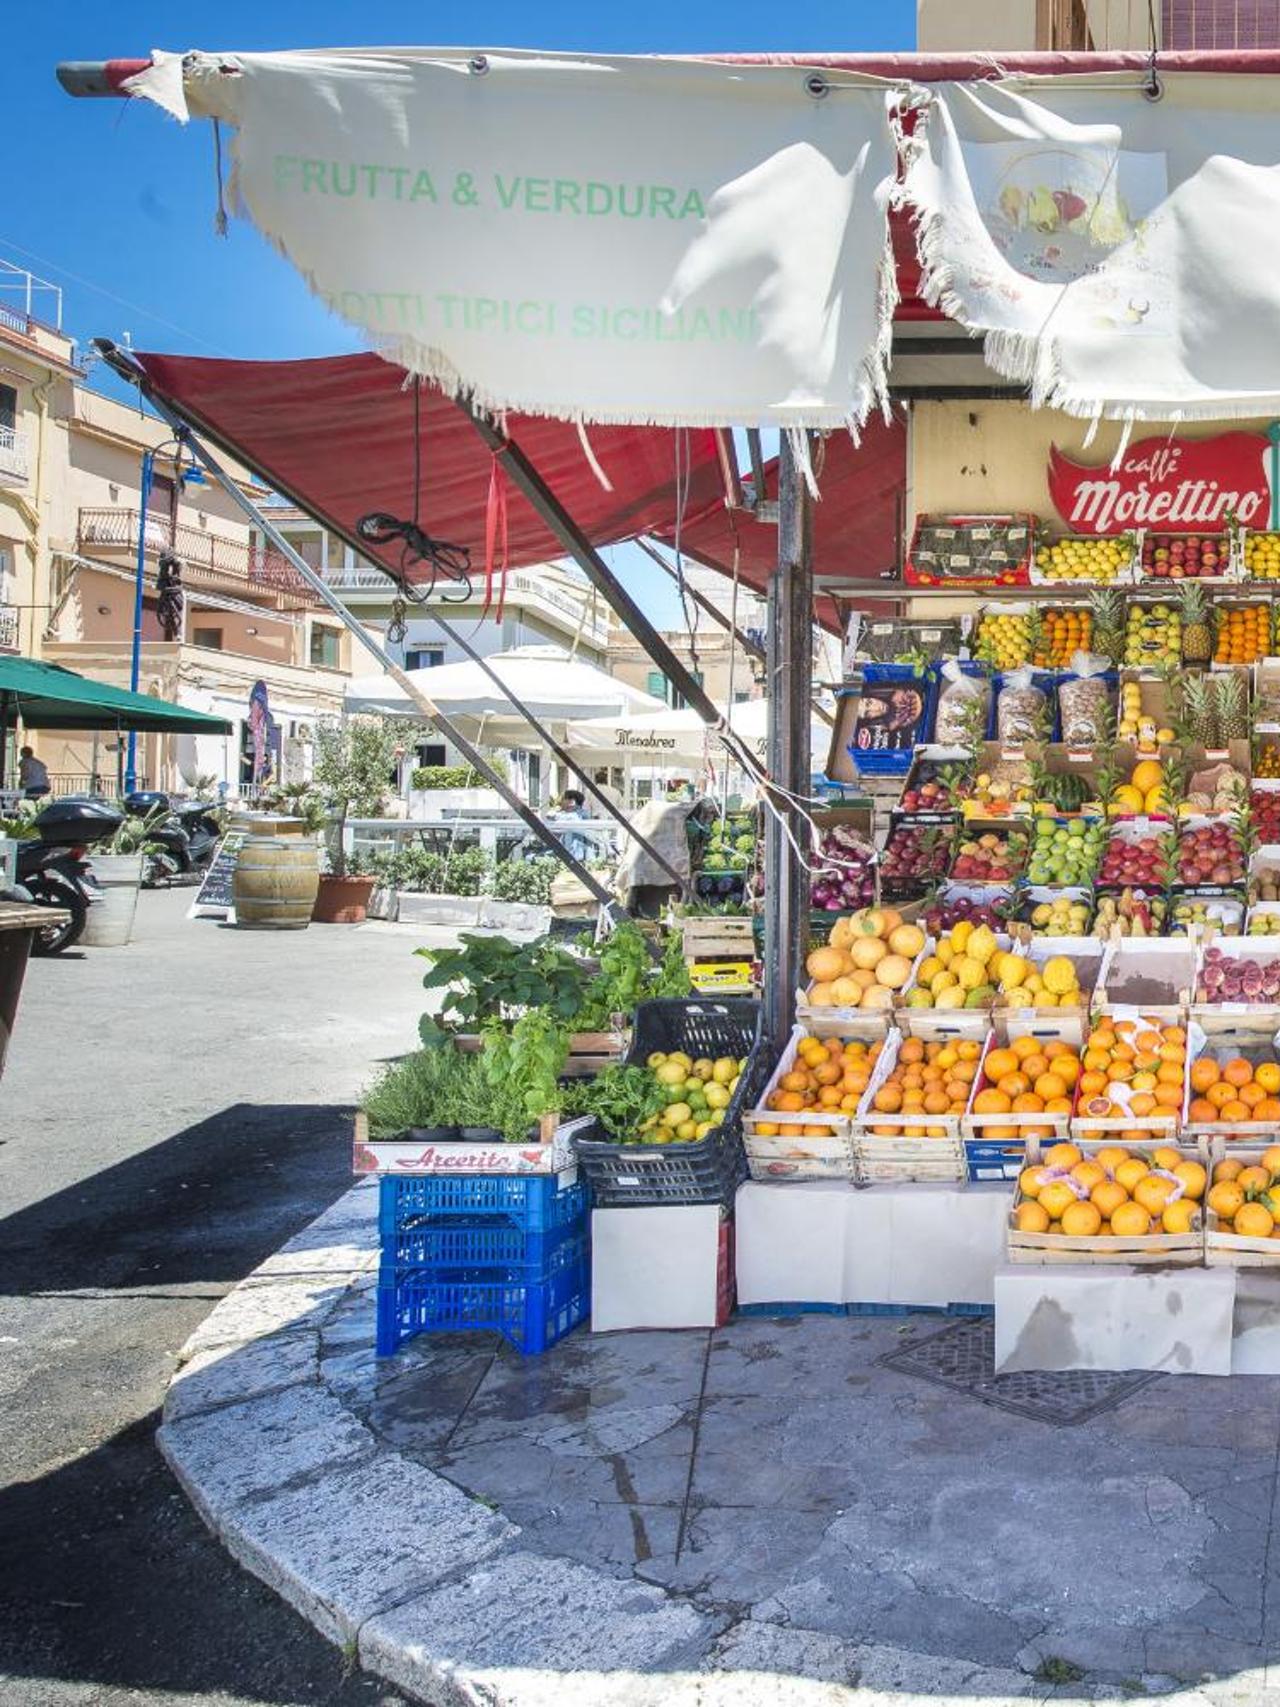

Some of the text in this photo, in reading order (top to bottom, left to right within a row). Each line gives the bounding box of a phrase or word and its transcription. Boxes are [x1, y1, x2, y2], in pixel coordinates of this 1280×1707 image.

[272, 154, 706, 220] FRUTTA & VERDURA
[434, 293, 557, 334] TIPICI
[1069, 479, 1264, 533] Morettino
